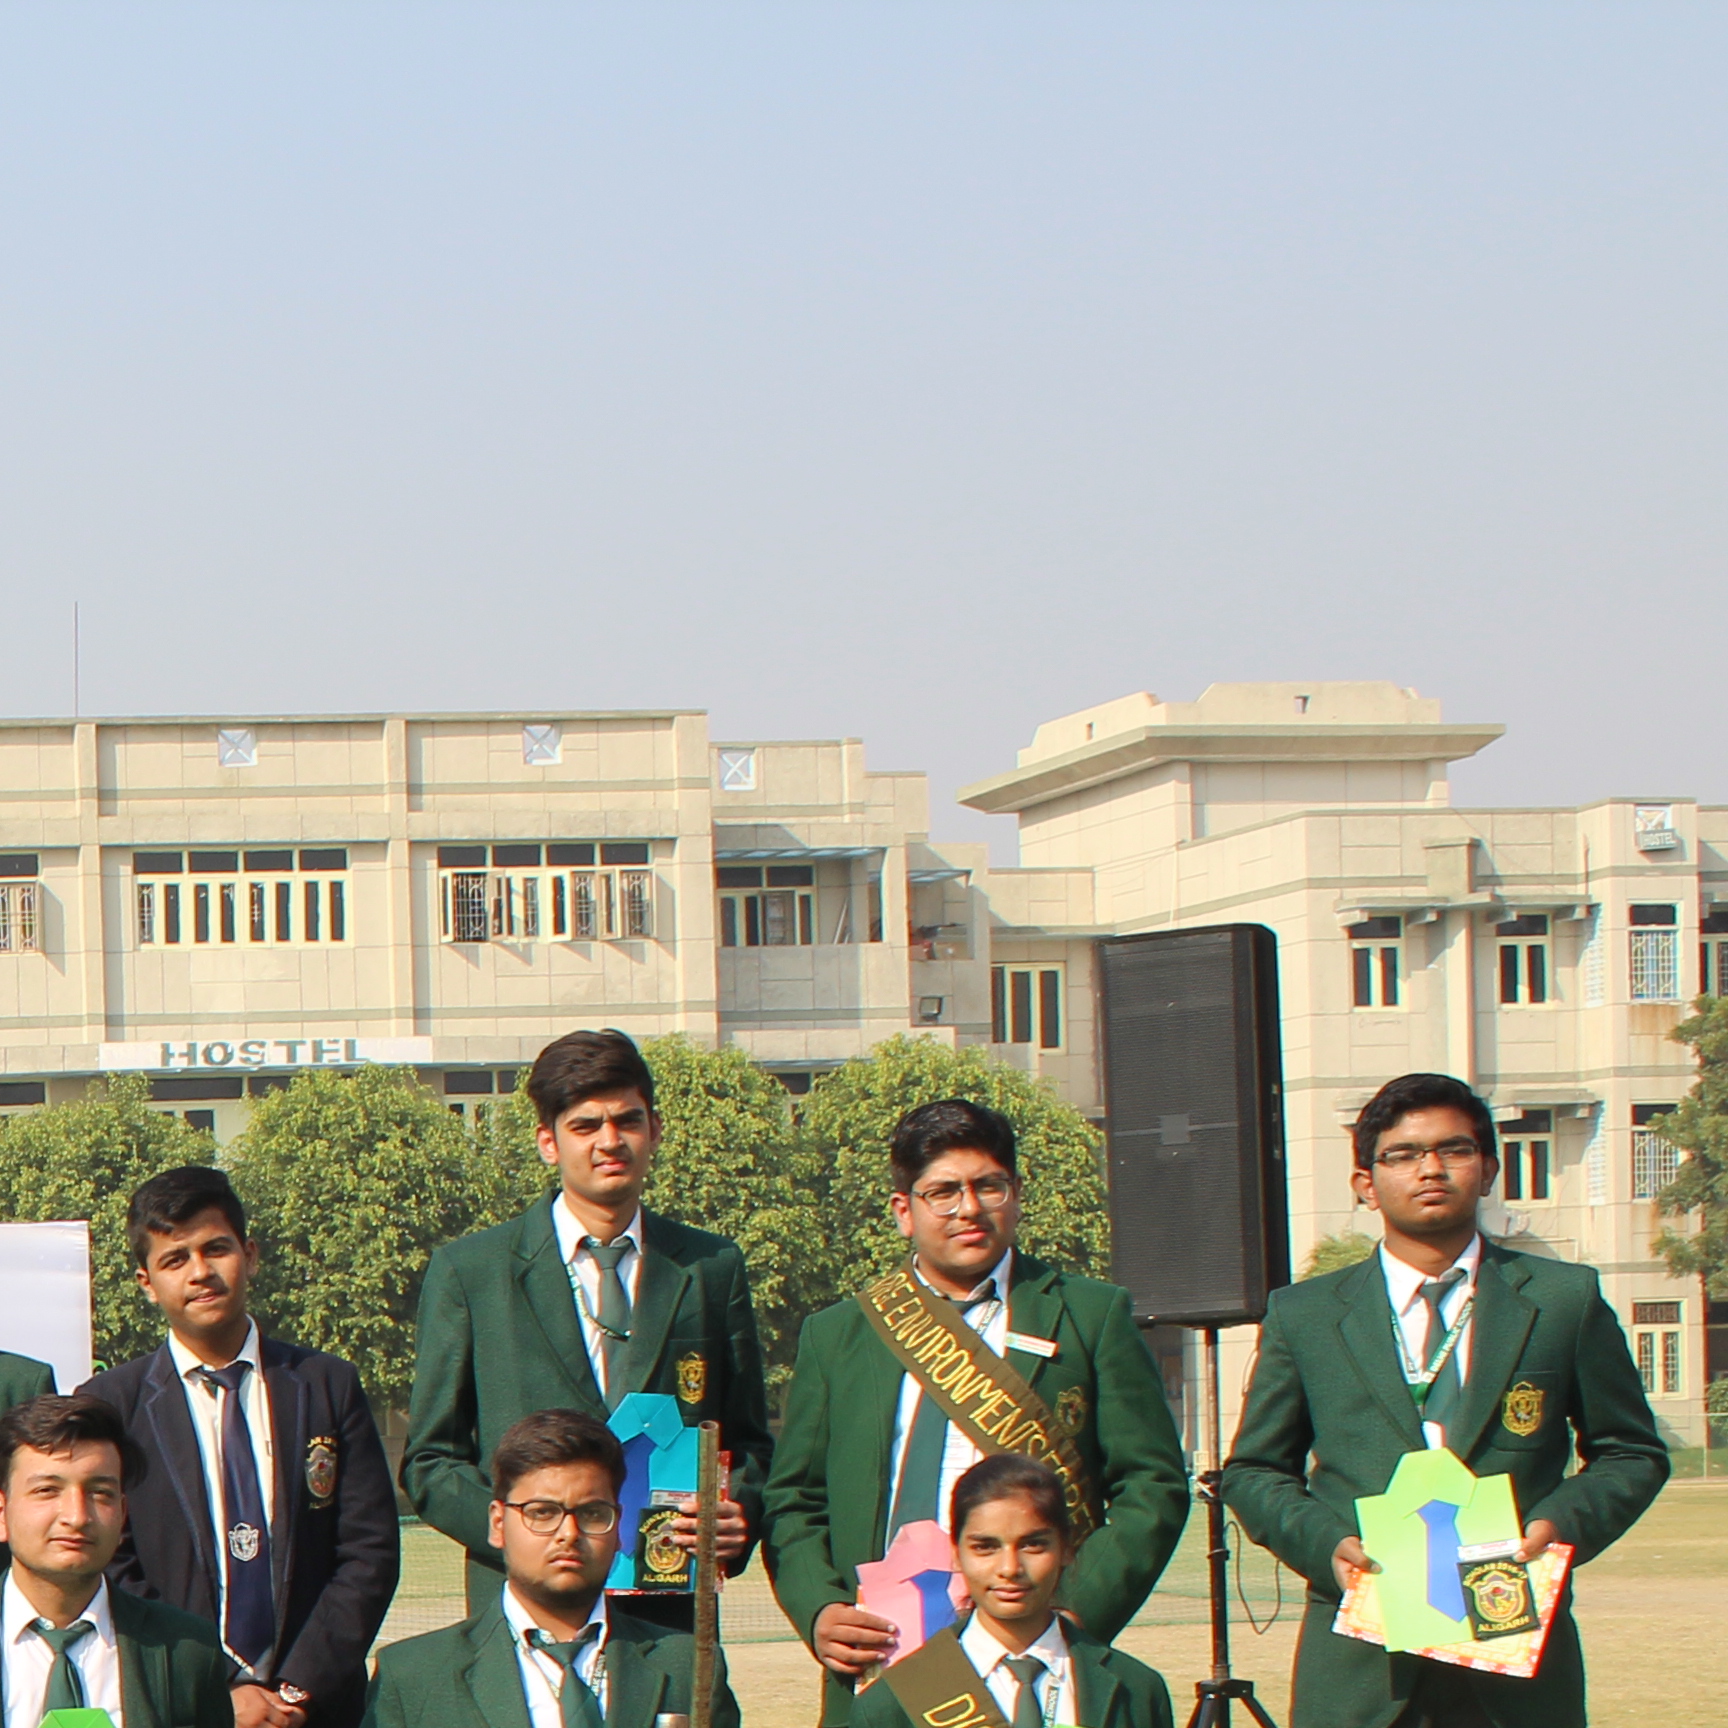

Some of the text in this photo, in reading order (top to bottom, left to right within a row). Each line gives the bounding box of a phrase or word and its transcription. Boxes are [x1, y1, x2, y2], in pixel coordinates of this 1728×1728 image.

[161, 1038, 371, 1067] HOSTEL
[883, 1296, 1046, 1450] ENVIRONMENT
[1477, 1615, 1530, 1632] ALIGARH
